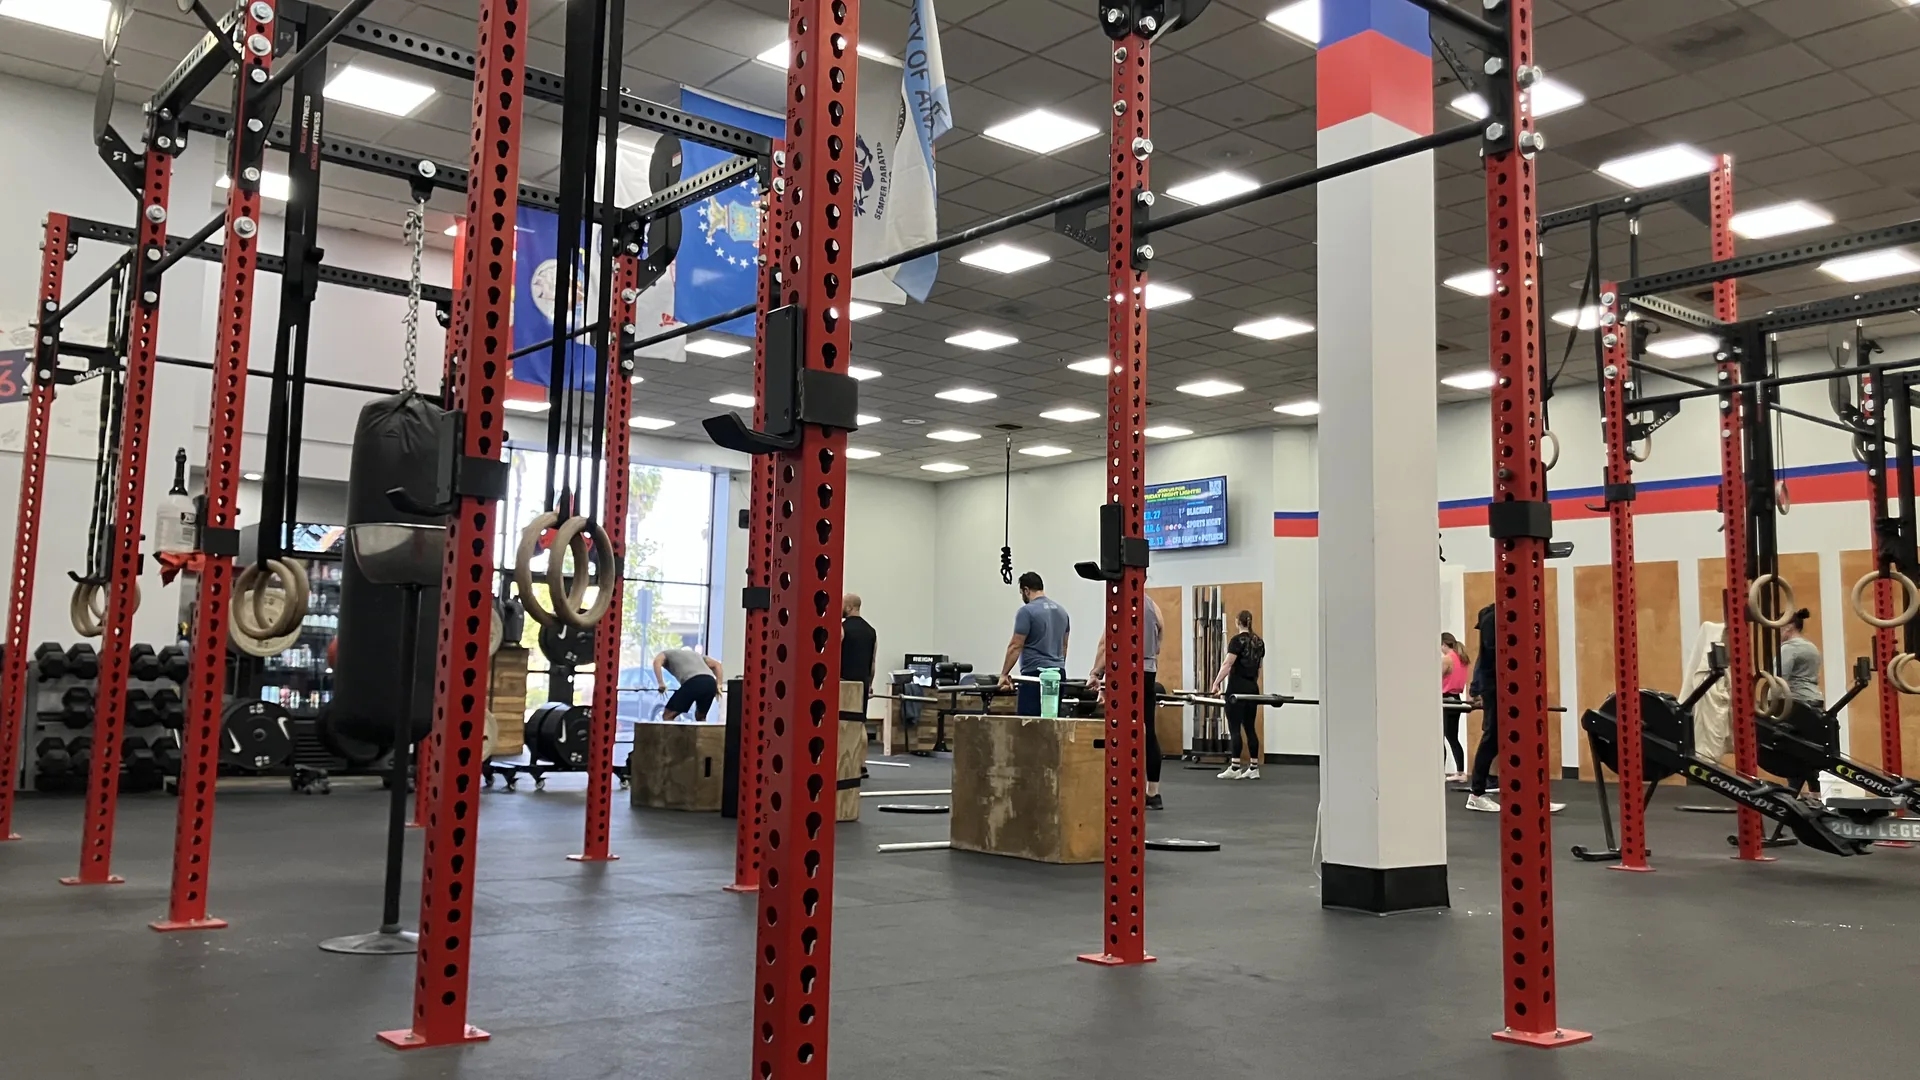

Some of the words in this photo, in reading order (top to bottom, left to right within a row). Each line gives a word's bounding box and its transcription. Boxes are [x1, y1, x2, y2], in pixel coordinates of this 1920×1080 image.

[907, 51, 930, 81] OF
[787, 108, 796, 119] 25
[785, 176, 794, 187] 23
[874, 186, 888, 220] SEMPER
[784, 209, 793, 221] 22
[783, 244, 792, 255] 21
[782, 279, 791, 290] 20
[1153, 510, 1160, 520] 27
[775, 523, 783, 532] 13
[1186, 519, 1205, 529] SPORTS
[774, 558, 782, 568] 12
[773, 594, 781, 603] 11
[771, 630, 780, 640] 10
[1776, 806, 1787, 817] 2
